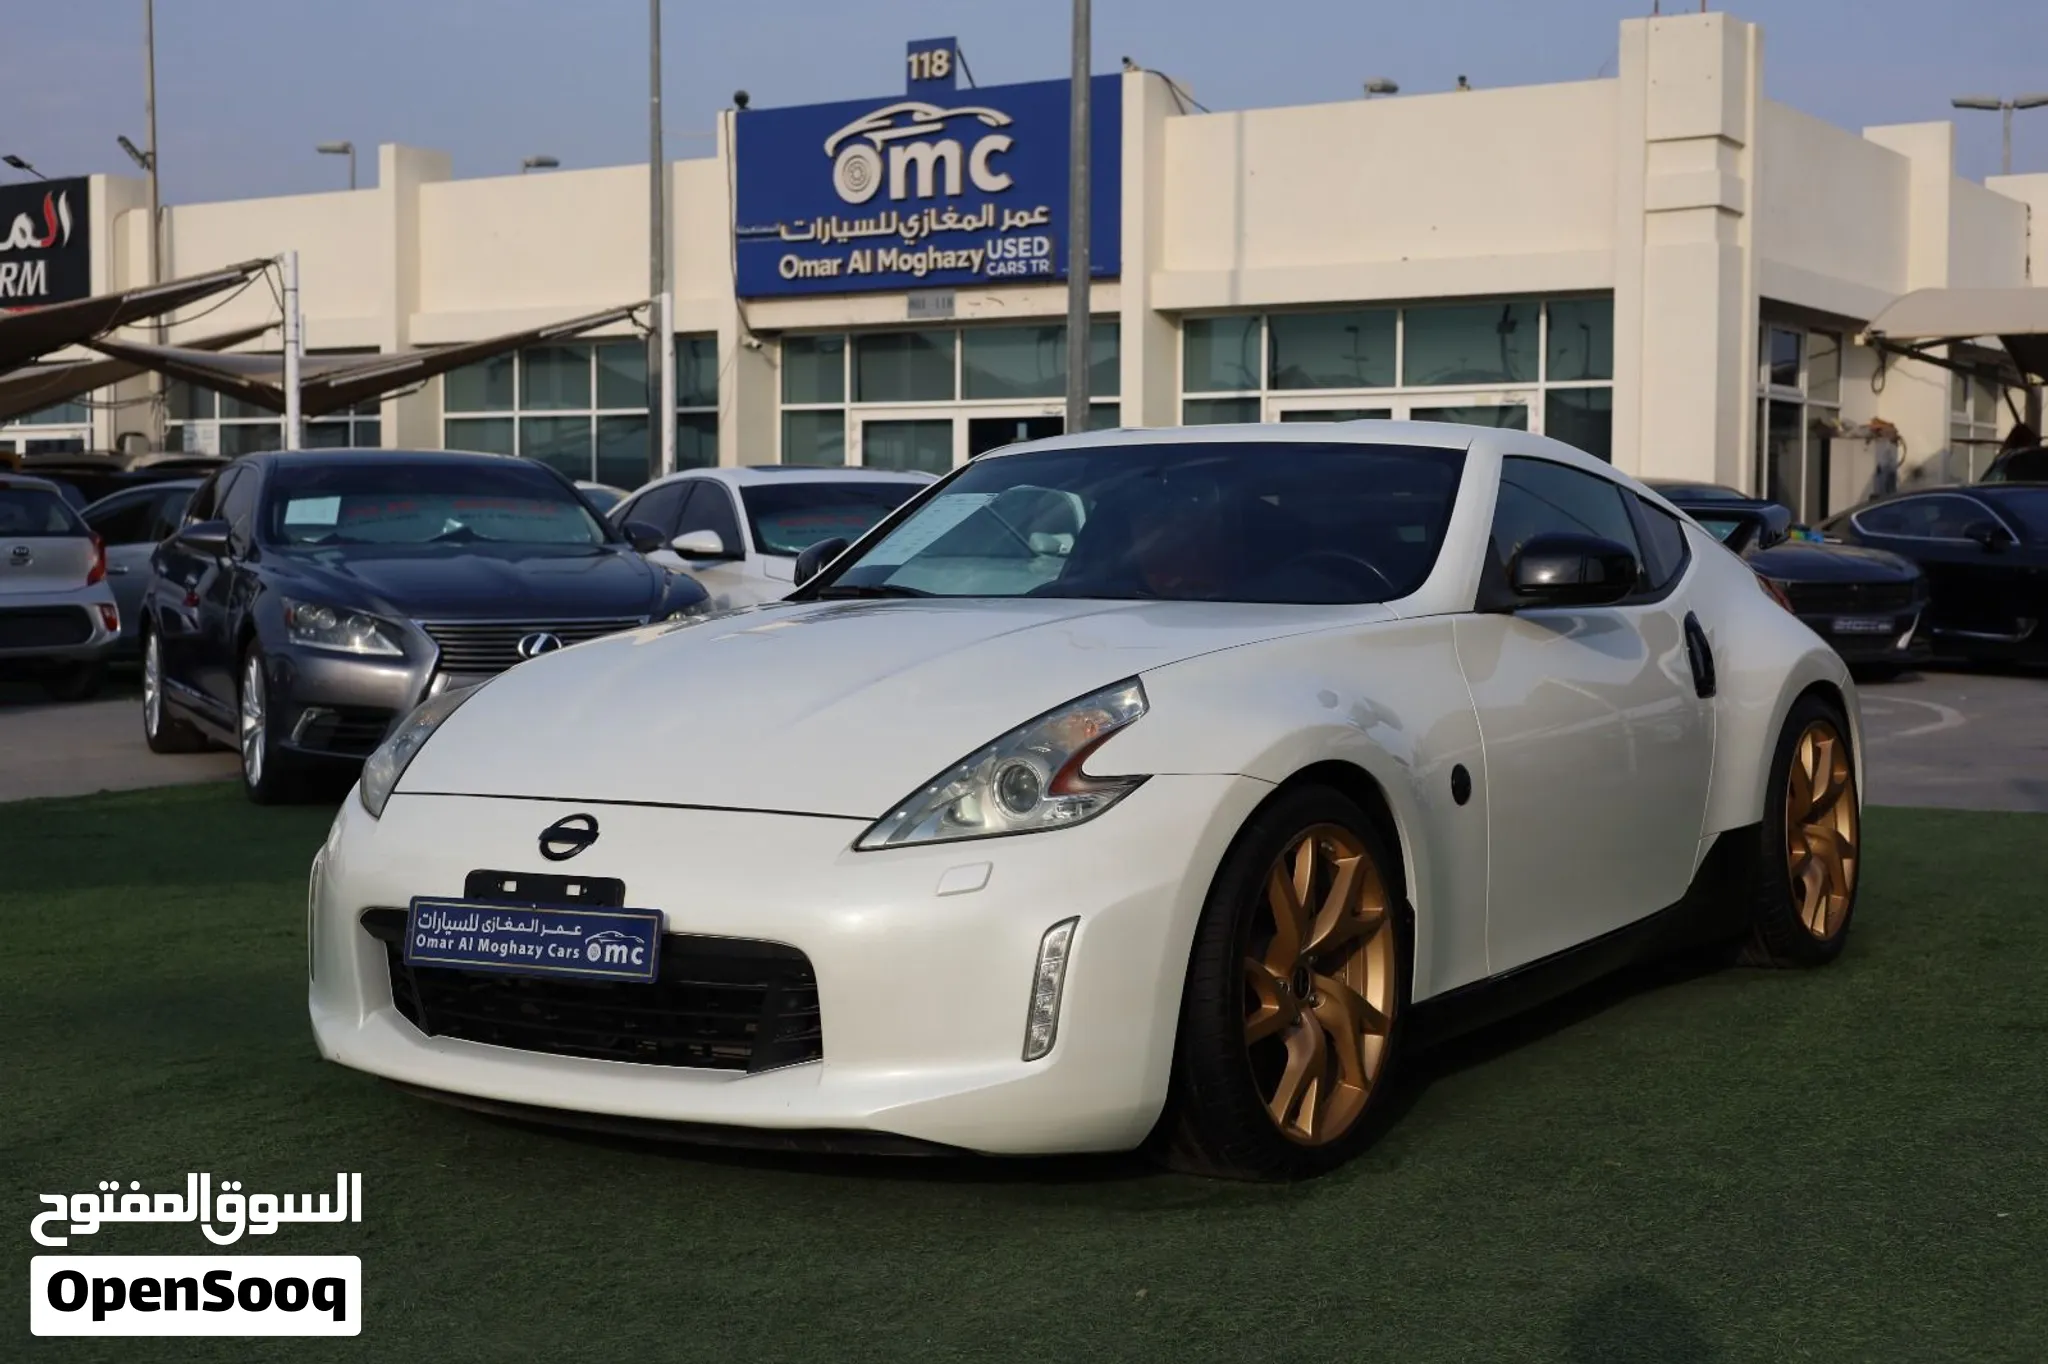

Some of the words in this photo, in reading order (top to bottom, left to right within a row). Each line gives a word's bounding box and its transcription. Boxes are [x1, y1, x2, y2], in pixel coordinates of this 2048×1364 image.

[907, 48, 949, 81] 118
[780, 211, 897, 245] للسيارات
[898, 203, 995, 245] المغازي
[1001, 204, 1049, 231] عمر
[987, 236, 1050, 259] USED
[779, 253, 842, 280] Omar
[847, 248, 872, 275] Al
[877, 245, 986, 278] Moghazy
[986, 261, 1026, 276] CARS
[1030, 259, 1050, 273] TR
[417, 911, 479, 935] للسيارات
[540, 925, 582, 937] عمر
[415, 934, 454, 951] Omar
[458, 936, 473, 952] Al
[477, 939, 543, 959] Moghazy
[547, 943, 581, 959] Cars
